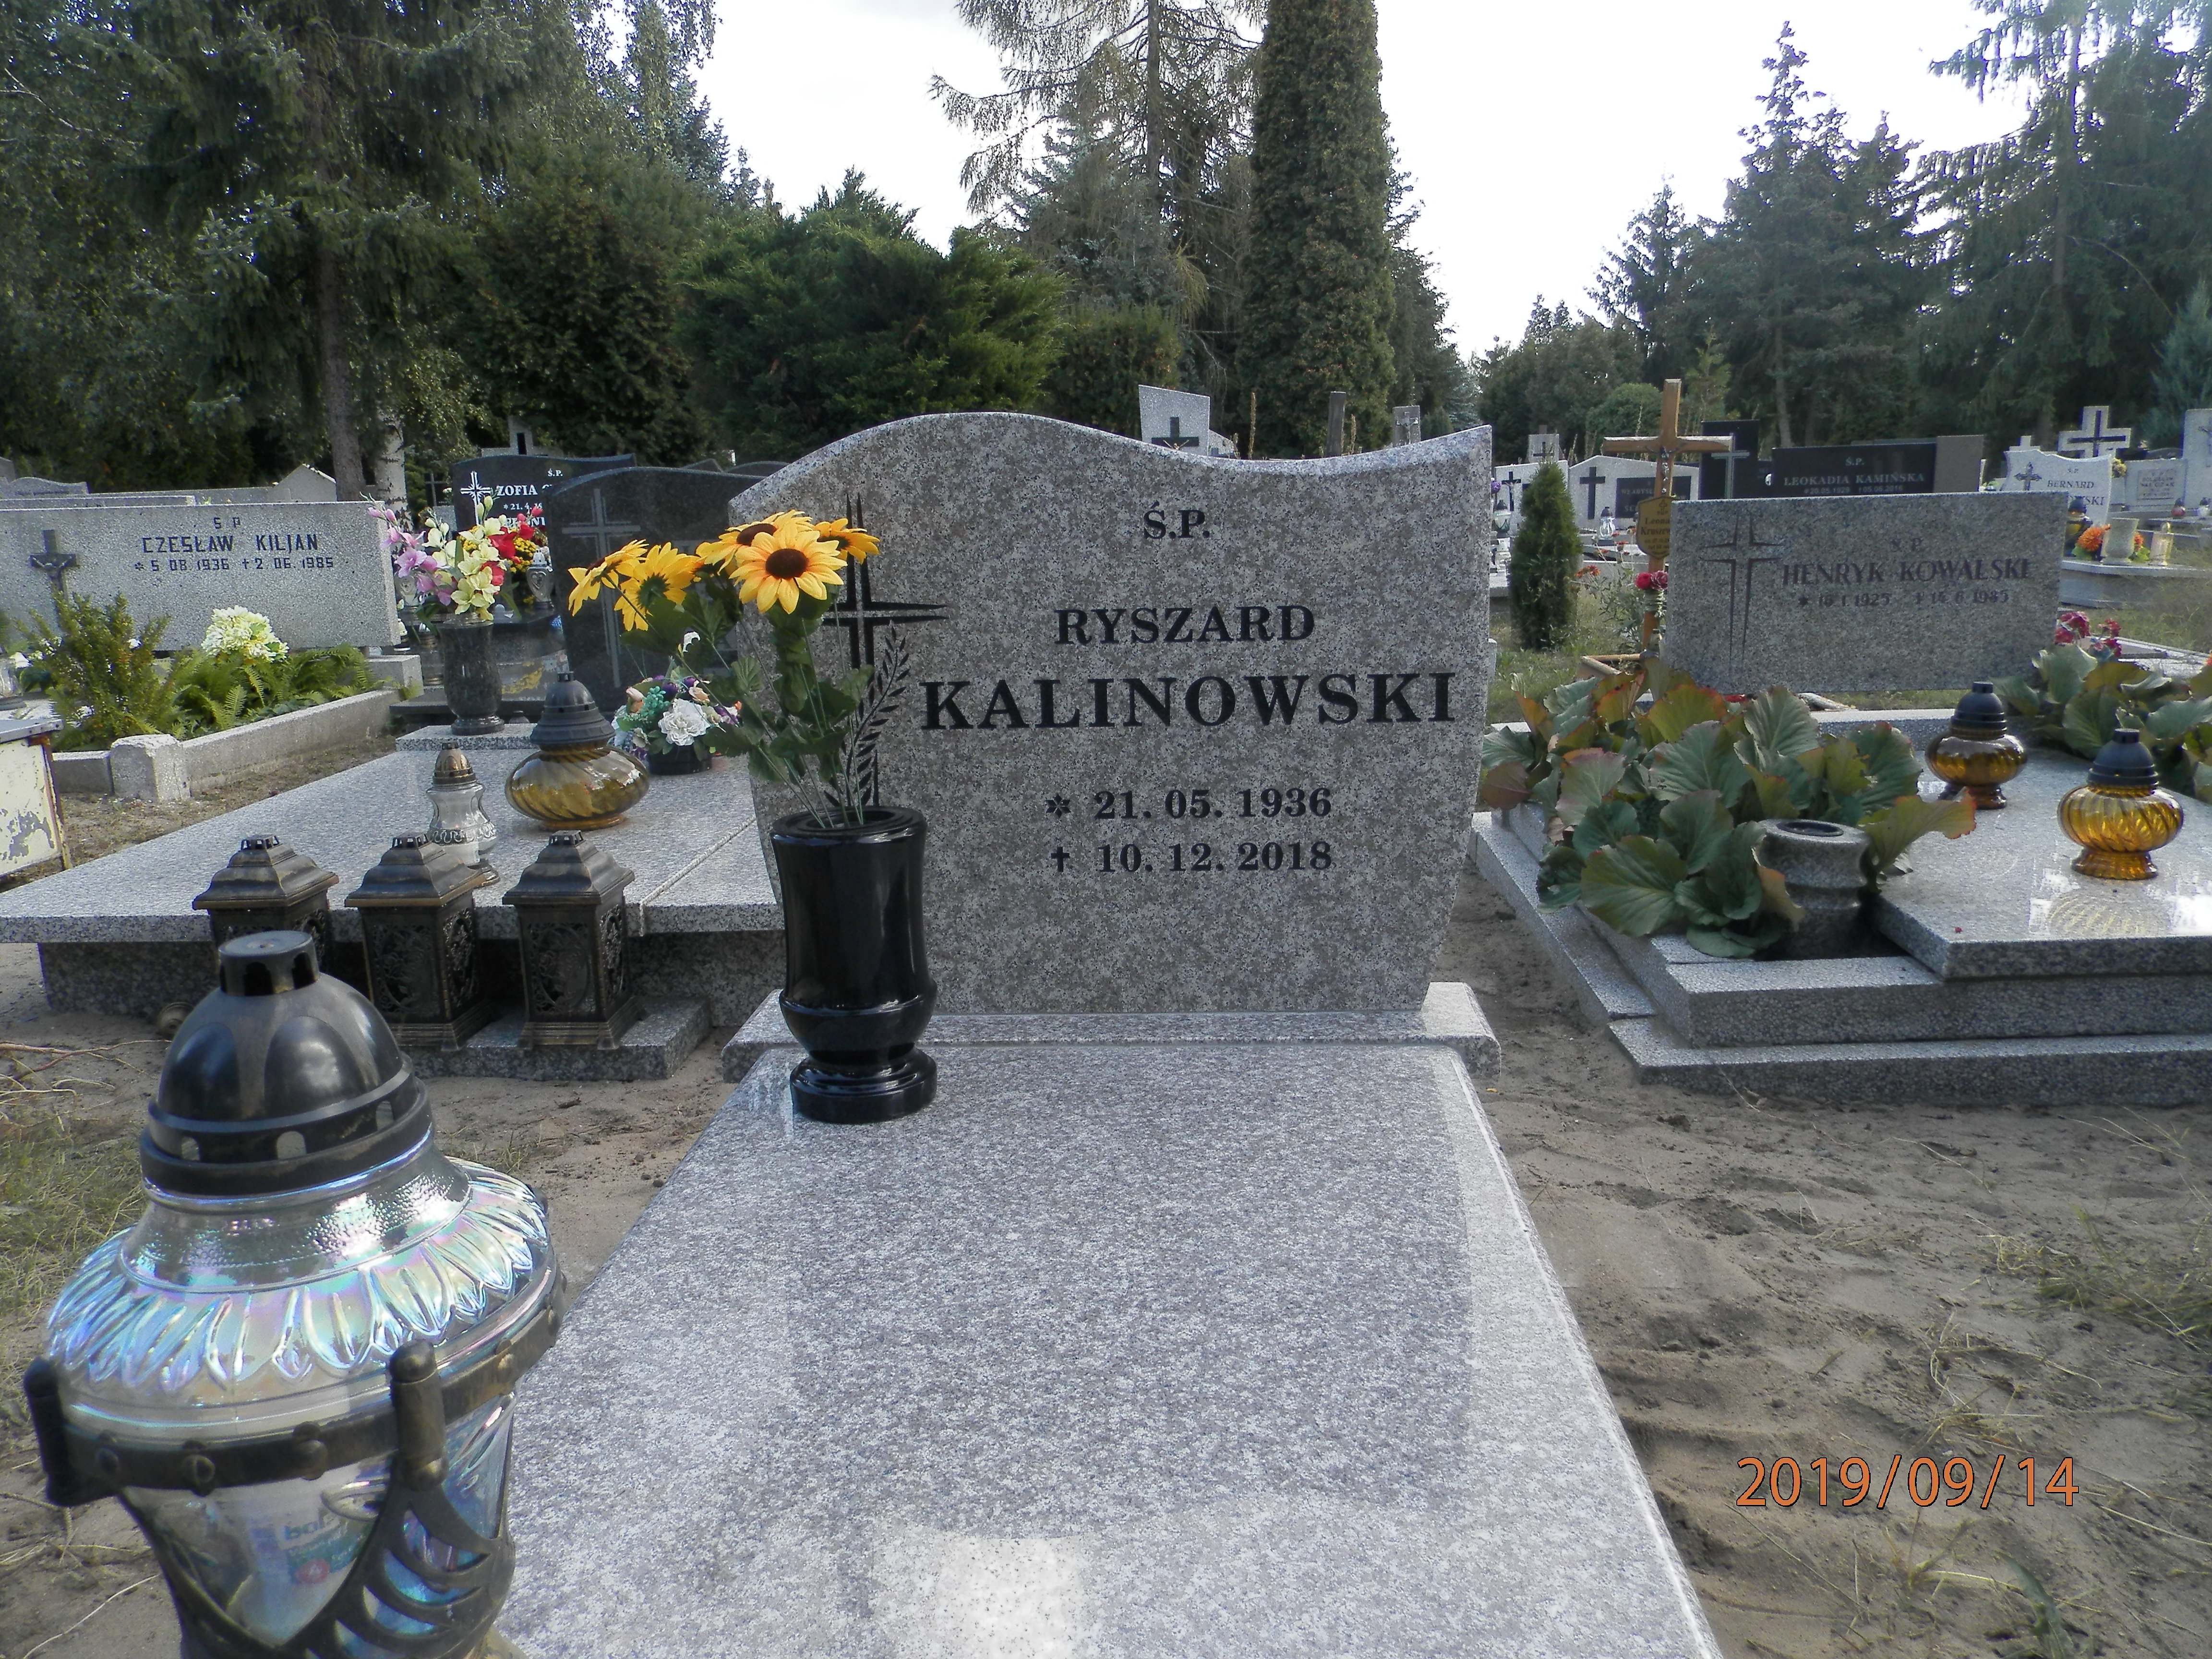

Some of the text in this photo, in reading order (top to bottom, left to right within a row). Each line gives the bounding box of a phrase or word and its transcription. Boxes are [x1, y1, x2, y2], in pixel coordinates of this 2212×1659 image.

[547, 468, 563, 477] Ś.P.
[1783, 475, 1850, 486] LEOKADIA
[496, 484, 538, 496] ZOFIA
[2047, 480, 2094, 489] BERNARD
[1143, 500, 1212, 539] Ś.P.
[142, 535, 234, 553] CZESŁAW
[302, 557, 334, 569] 1985
[1782, 558, 2029, 586] HENRYK KOWALSKI
[1055, 605, 1315, 646] RYSZARD
[919, 672, 1455, 732] KALINOWSKI
[1238, 788, 1332, 818] 1936
[1238, 841, 1333, 871] 2018
